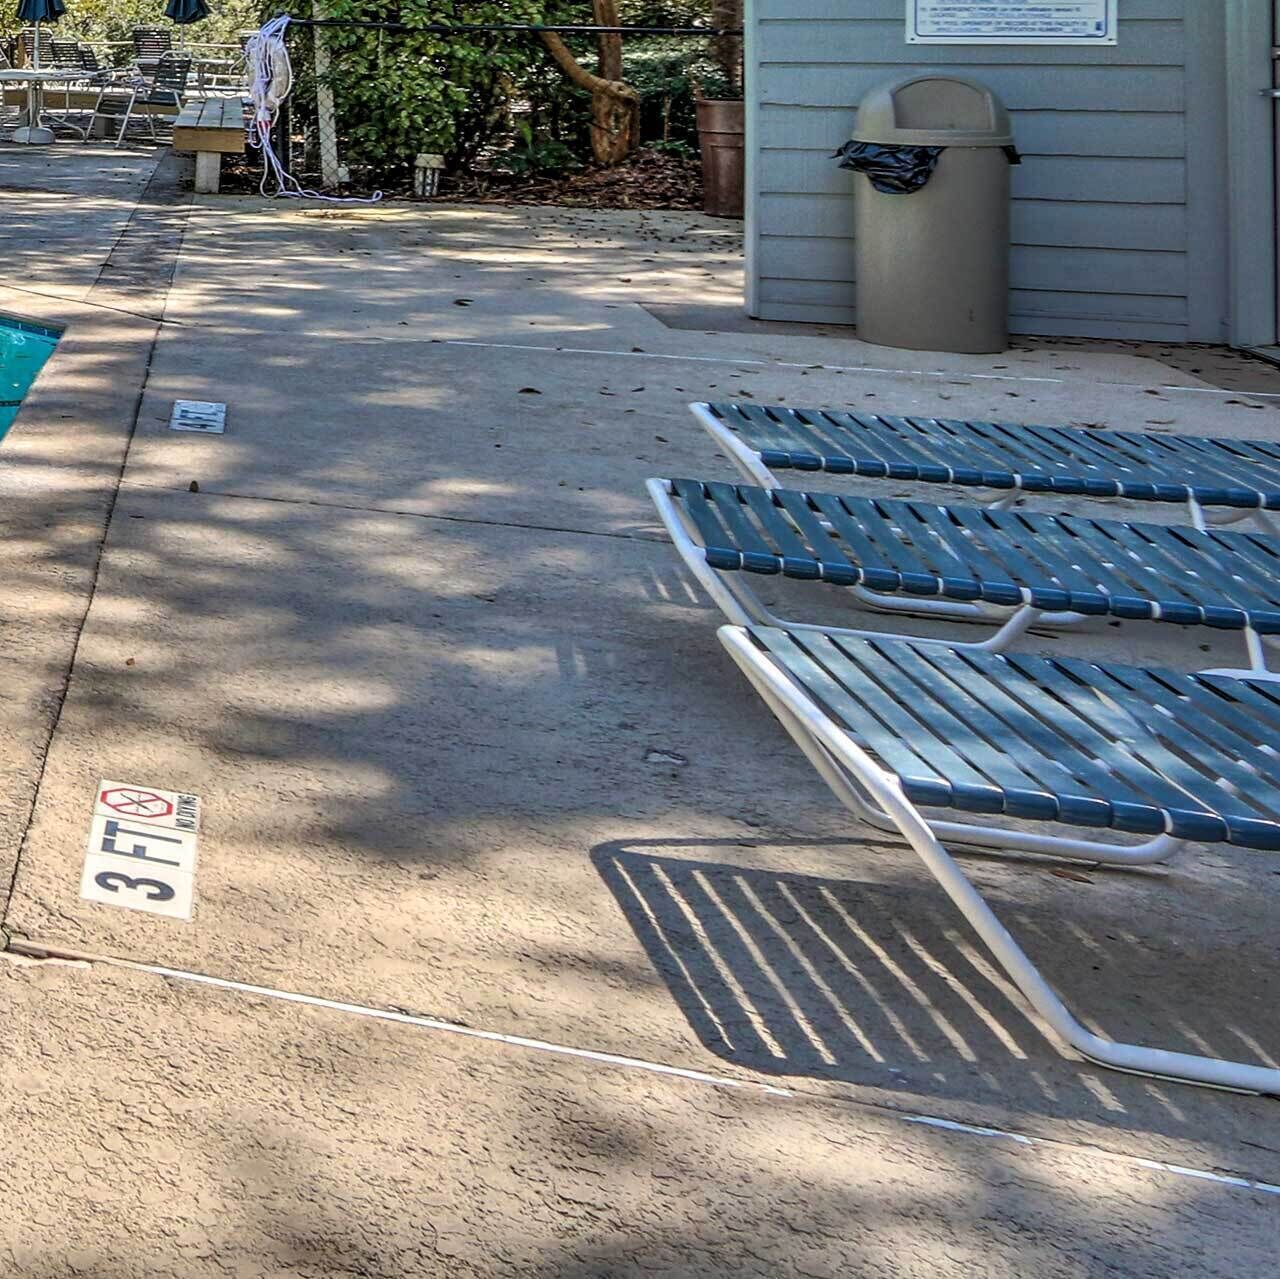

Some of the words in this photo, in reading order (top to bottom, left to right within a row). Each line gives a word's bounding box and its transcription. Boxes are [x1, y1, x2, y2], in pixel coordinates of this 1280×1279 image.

[175, 794, 198, 819] DIVING
[175, 817, 196, 830] NO
[100, 819, 183, 868] FT
[94, 871, 176, 902] 3
